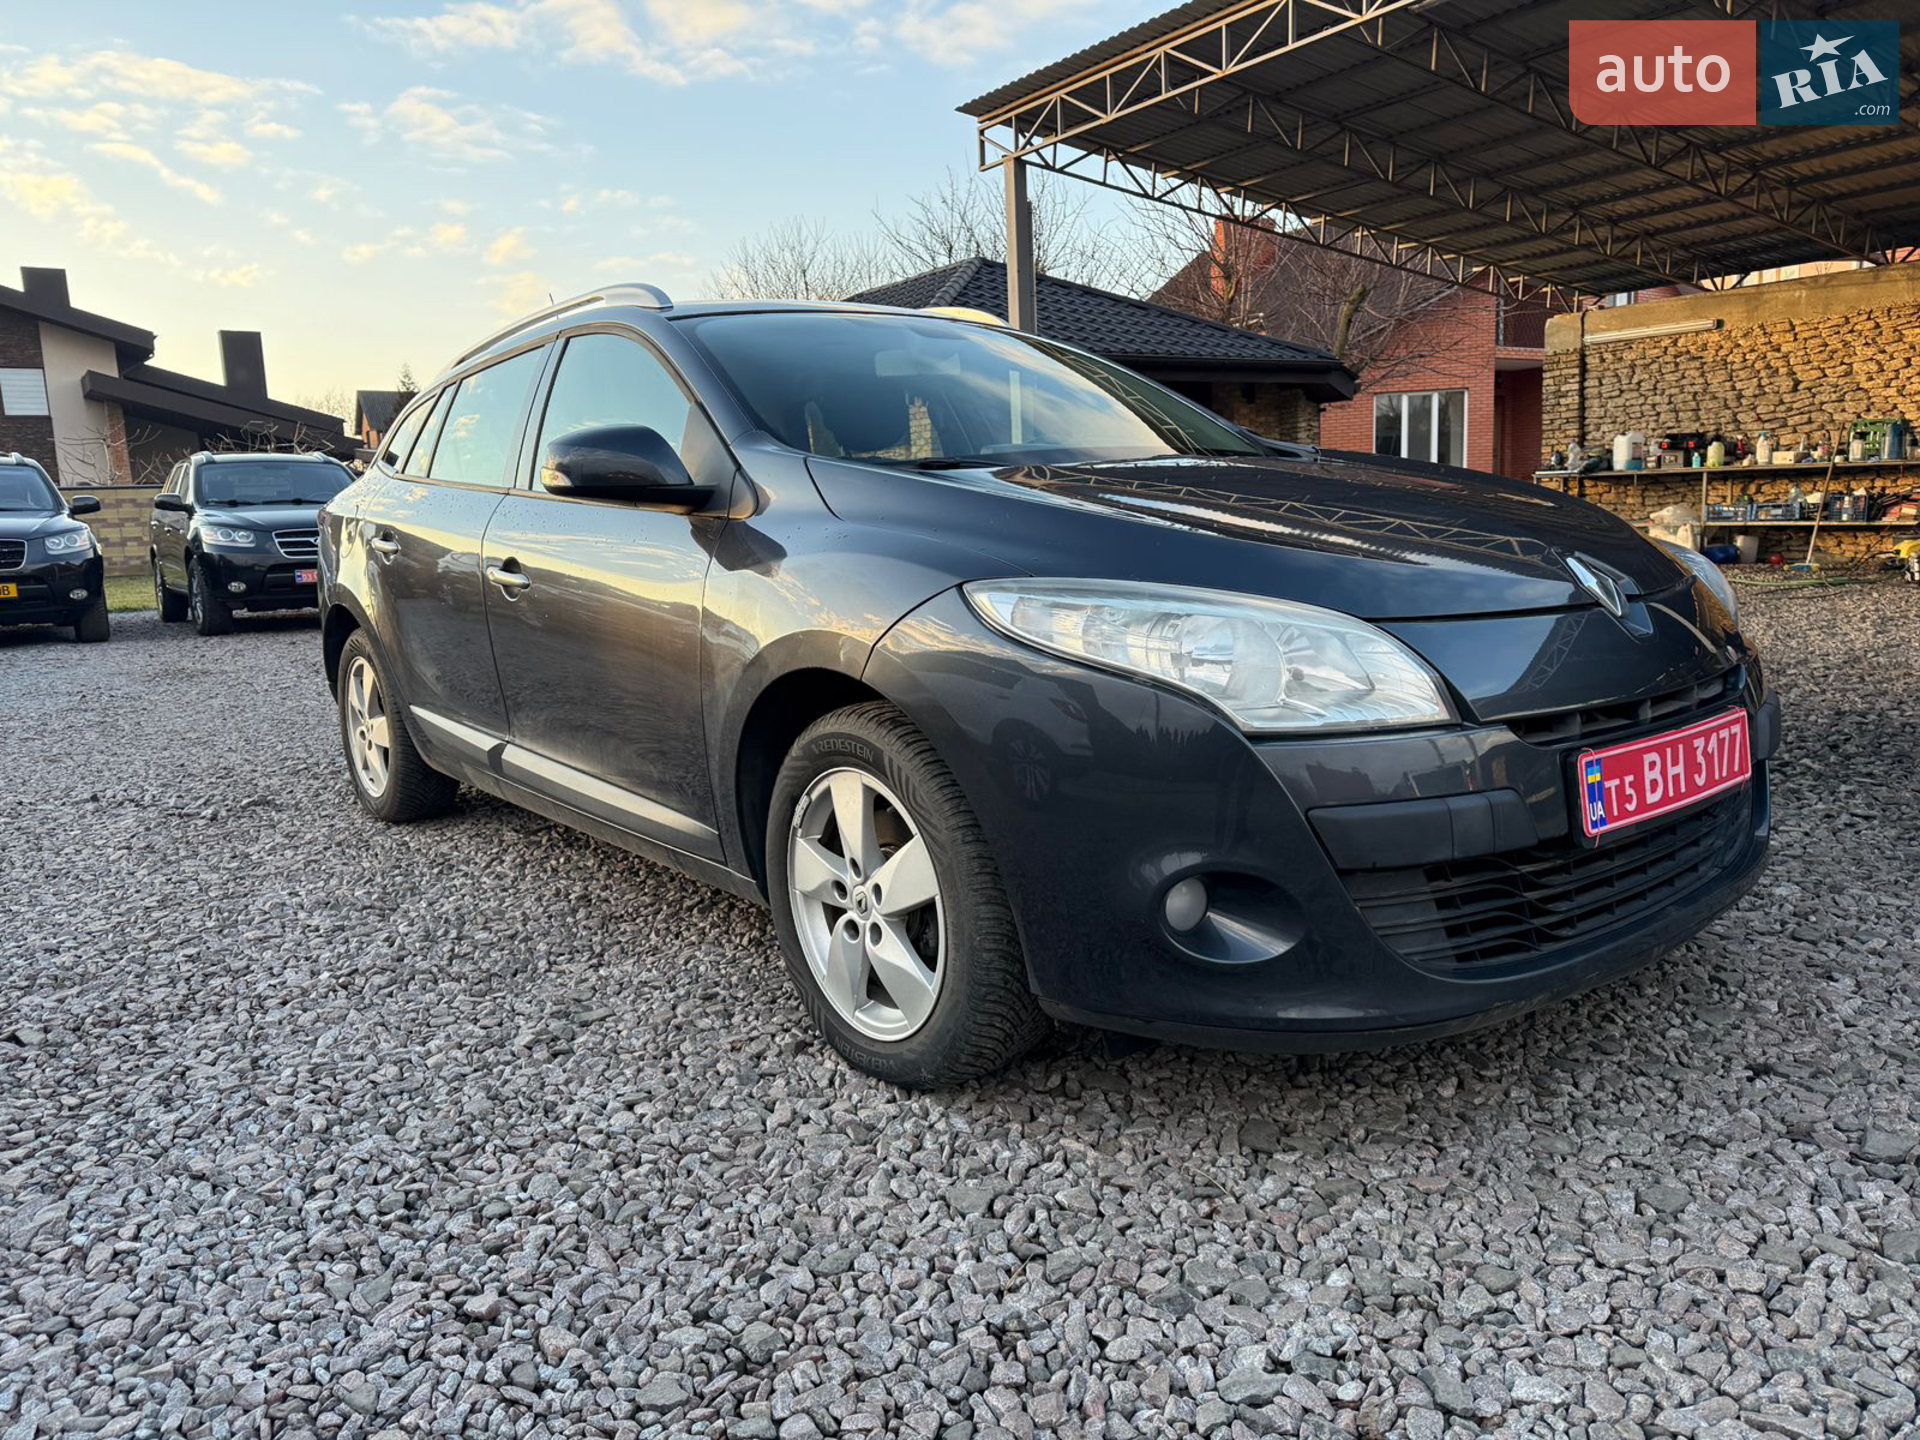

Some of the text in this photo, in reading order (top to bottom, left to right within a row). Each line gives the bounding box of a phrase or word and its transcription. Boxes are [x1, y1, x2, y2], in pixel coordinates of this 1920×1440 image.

[812, 738, 874, 762] VREDESTEIN
[1604, 723, 1741, 817] T5 BH 3177
[1590, 801, 1606, 822] UA
